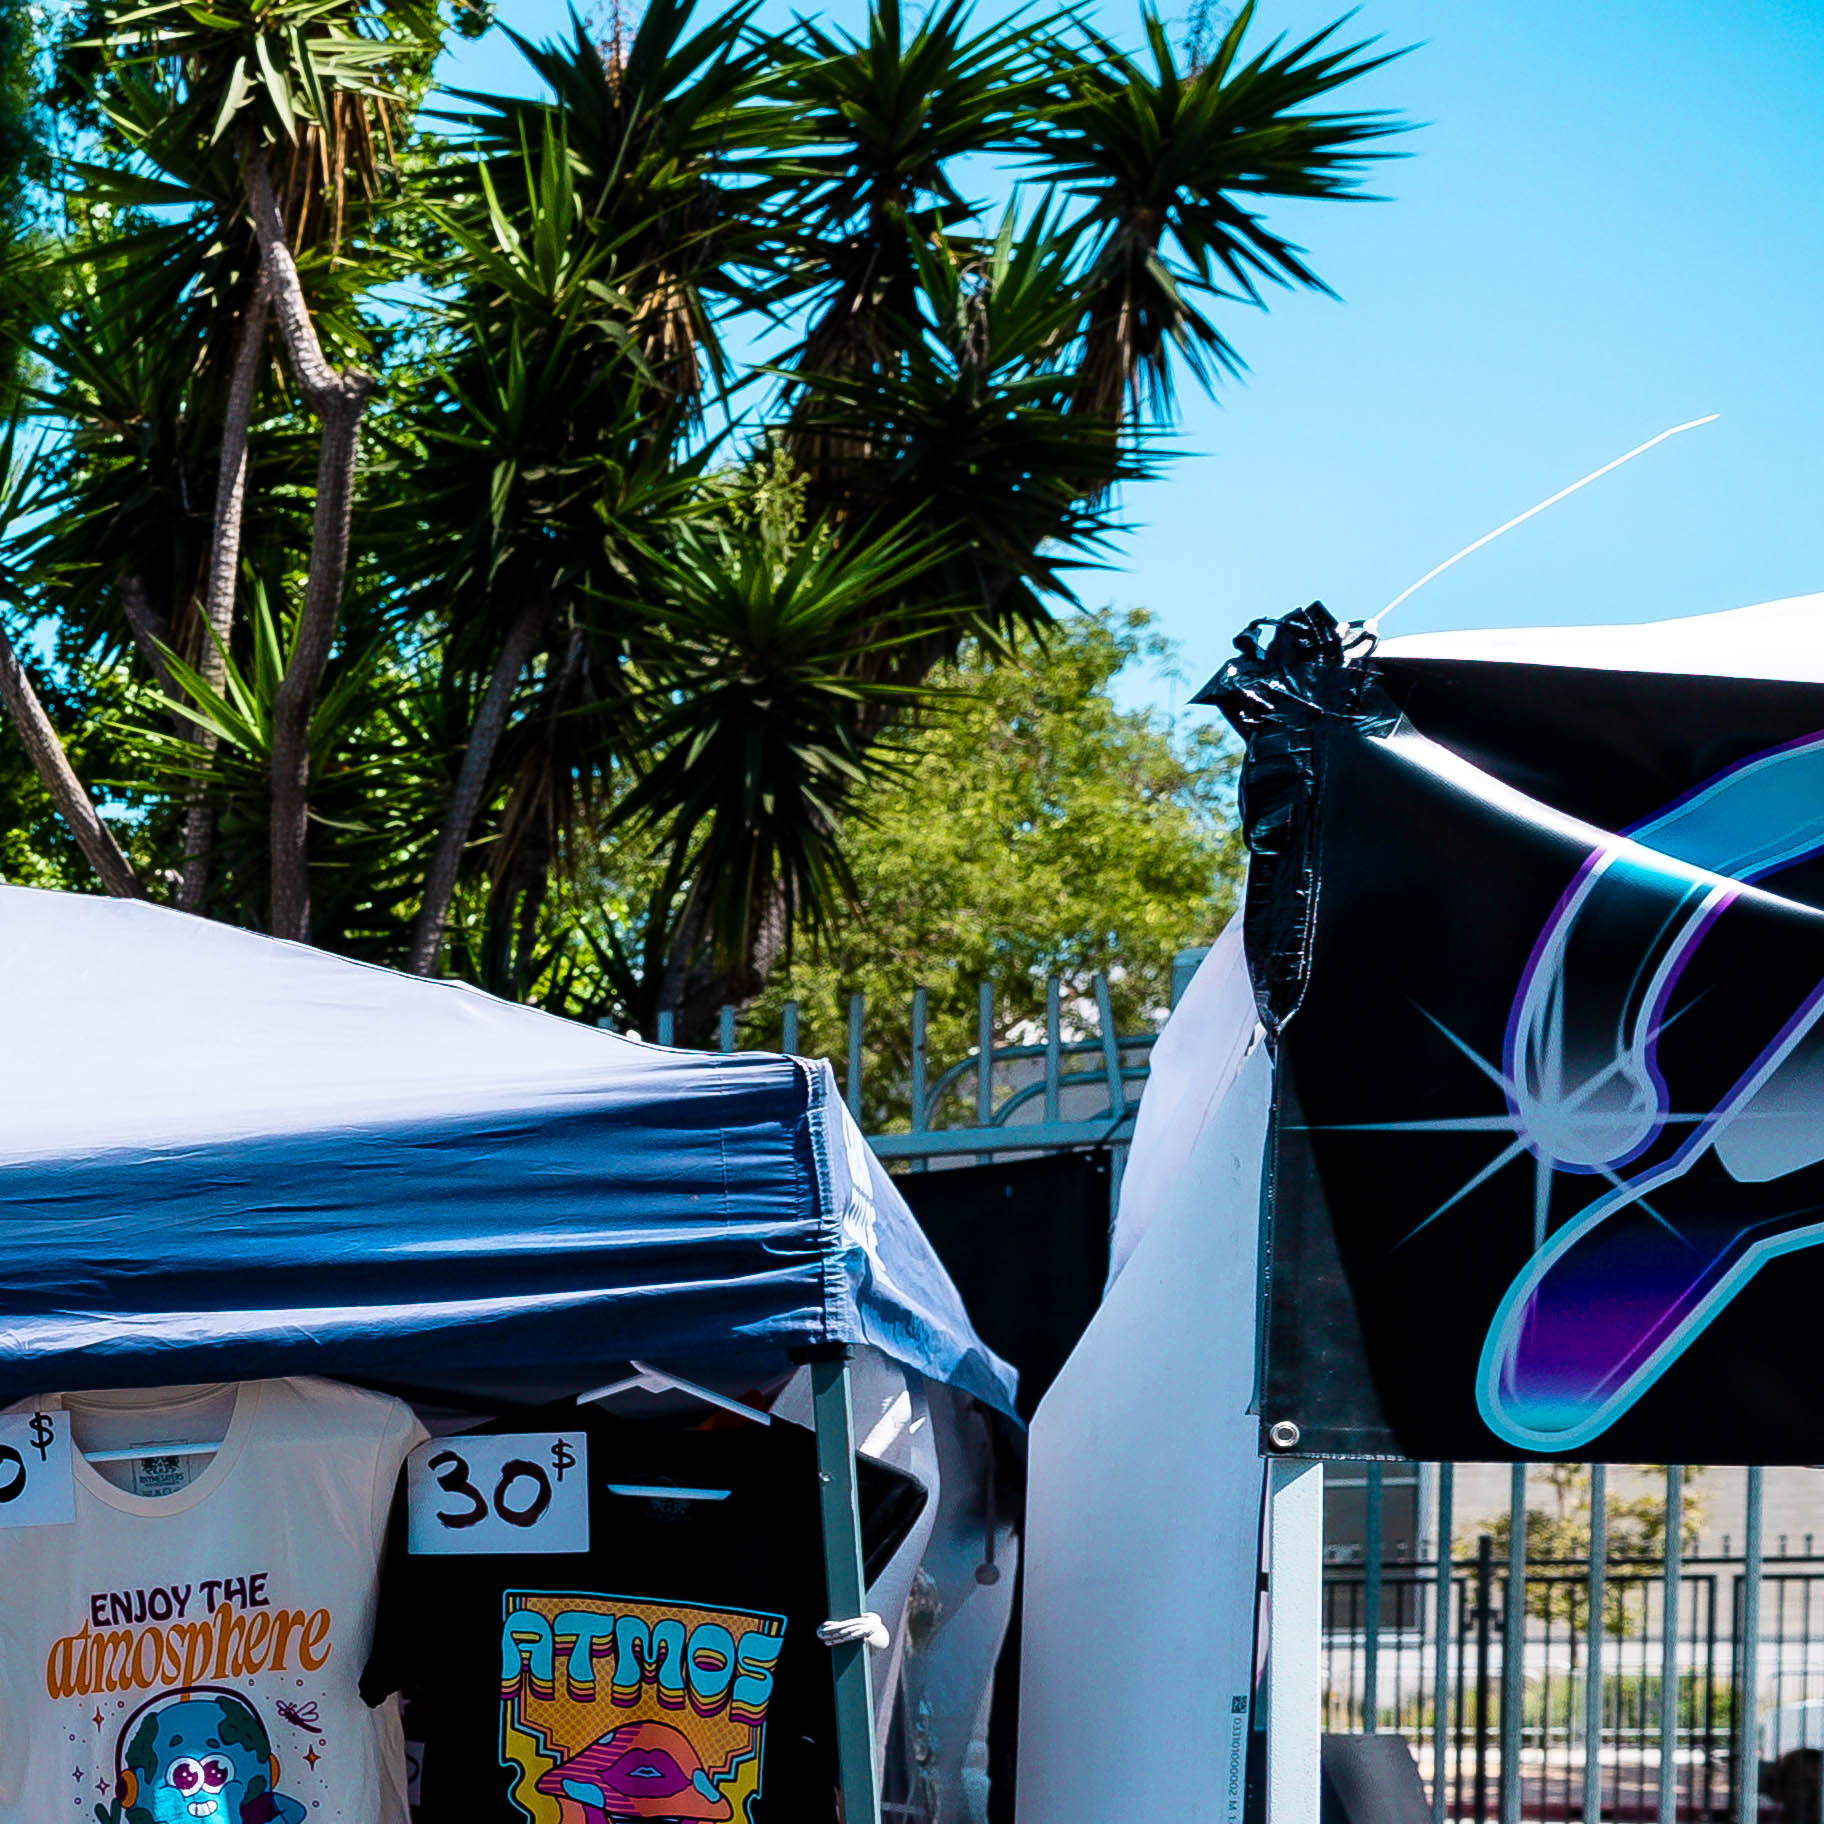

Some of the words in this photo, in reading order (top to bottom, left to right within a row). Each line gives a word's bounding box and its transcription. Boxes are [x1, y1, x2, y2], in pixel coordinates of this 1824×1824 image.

[90, 1584, 192, 1628] ENJOY
[198, 1572, 271, 1614] THE
[46, 1601, 333, 1703] atmosphere
[499, 1609, 784, 1727] ATMOS
